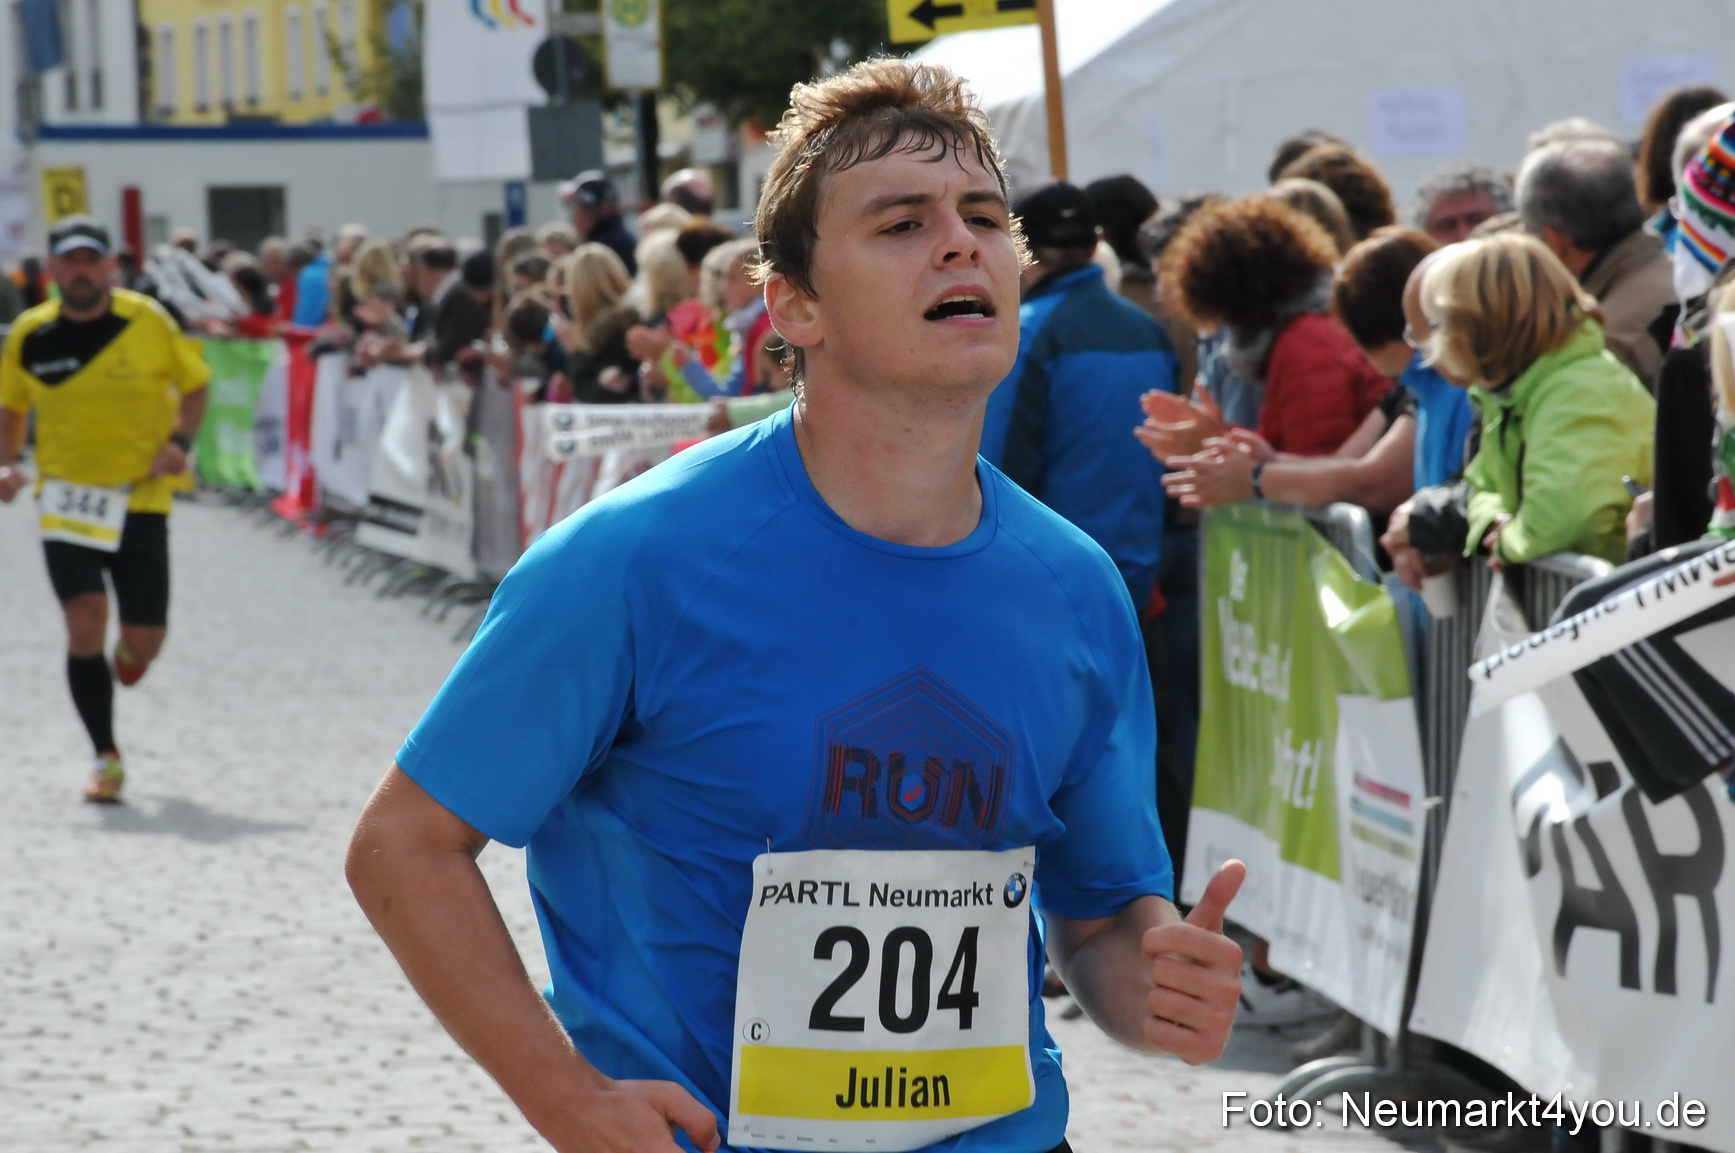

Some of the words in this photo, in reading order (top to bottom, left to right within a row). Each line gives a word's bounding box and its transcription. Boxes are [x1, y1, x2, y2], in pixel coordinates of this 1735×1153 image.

[824, 743, 1004, 831] RUN
[760, 881, 860, 906] PARTL
[869, 881, 994, 907] Neumarkt
[808, 926, 980, 1033] 204
[750, 1023, 762, 1041] C
[836, 1066, 951, 1108] Julian
